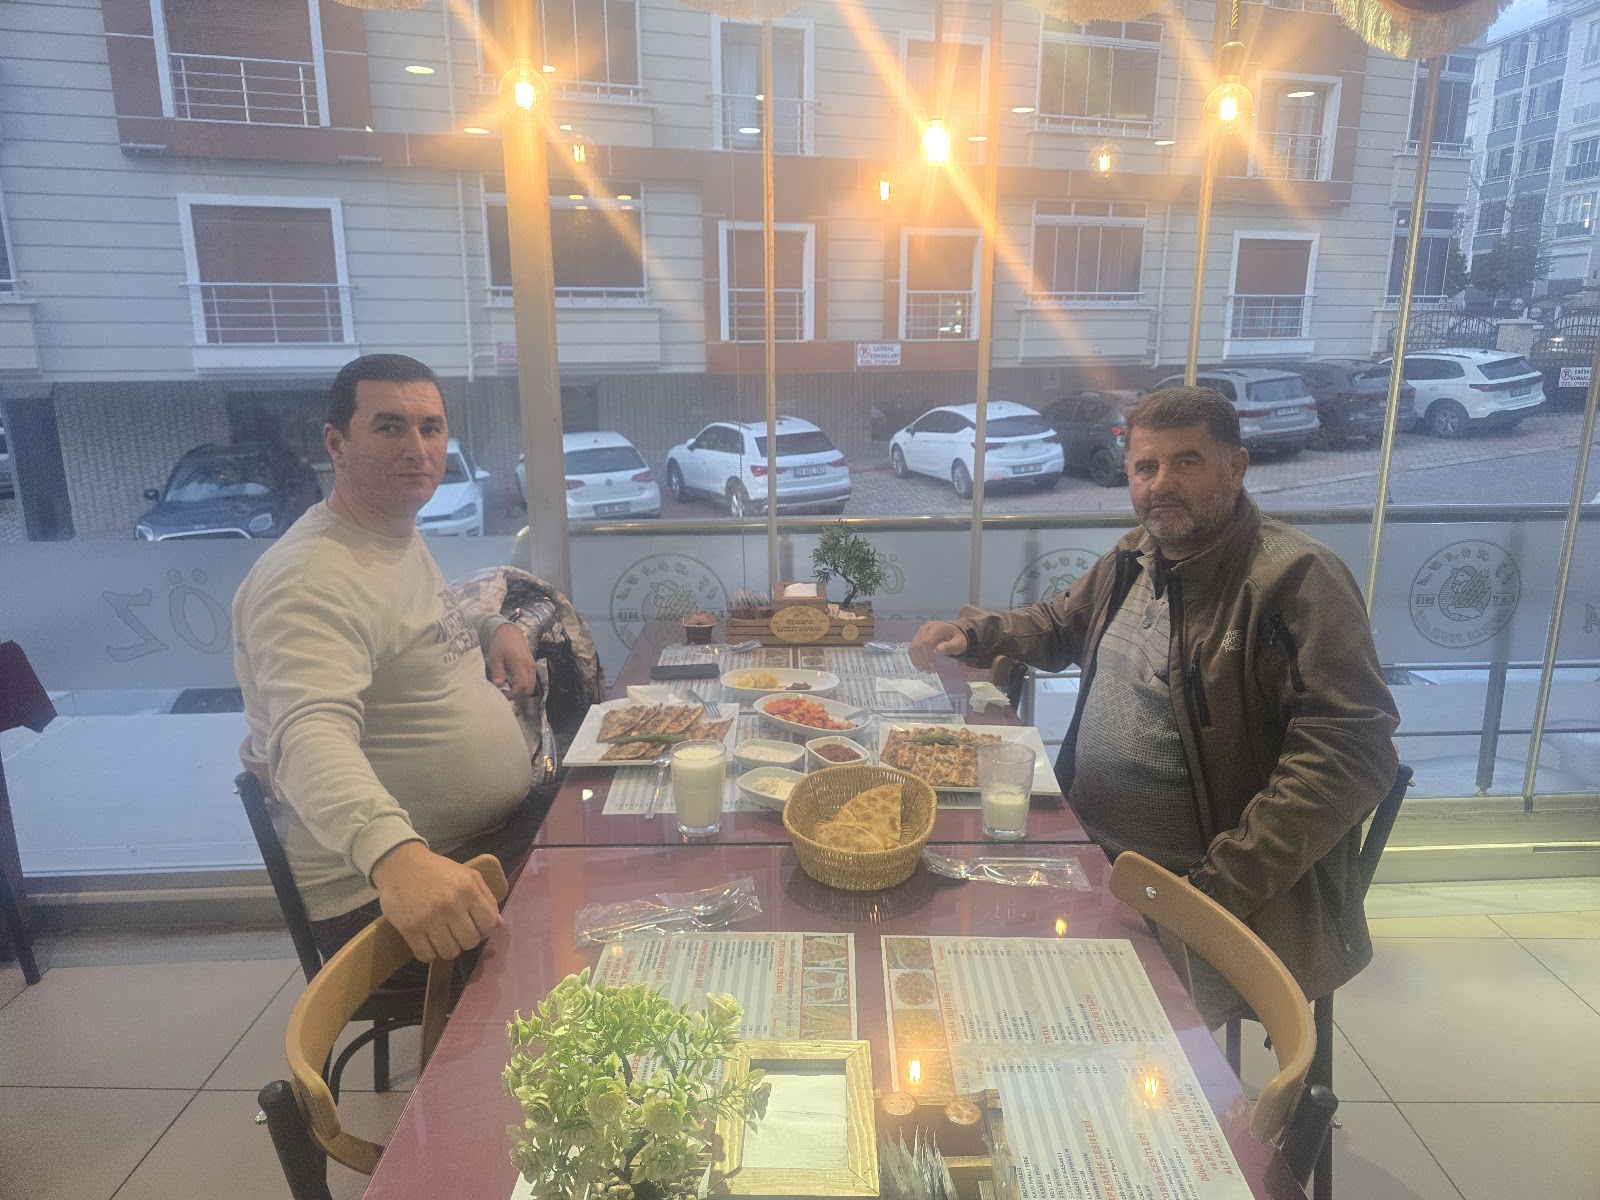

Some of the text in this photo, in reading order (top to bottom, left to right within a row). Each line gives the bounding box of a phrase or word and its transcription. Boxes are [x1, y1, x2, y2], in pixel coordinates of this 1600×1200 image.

[1081, 1120, 1103, 1160] ÇEŞİTLERİ
[1135, 1132, 1162, 1173] ÇEŞİTLERİ
[1221, 1160, 1234, 1175] ALO
